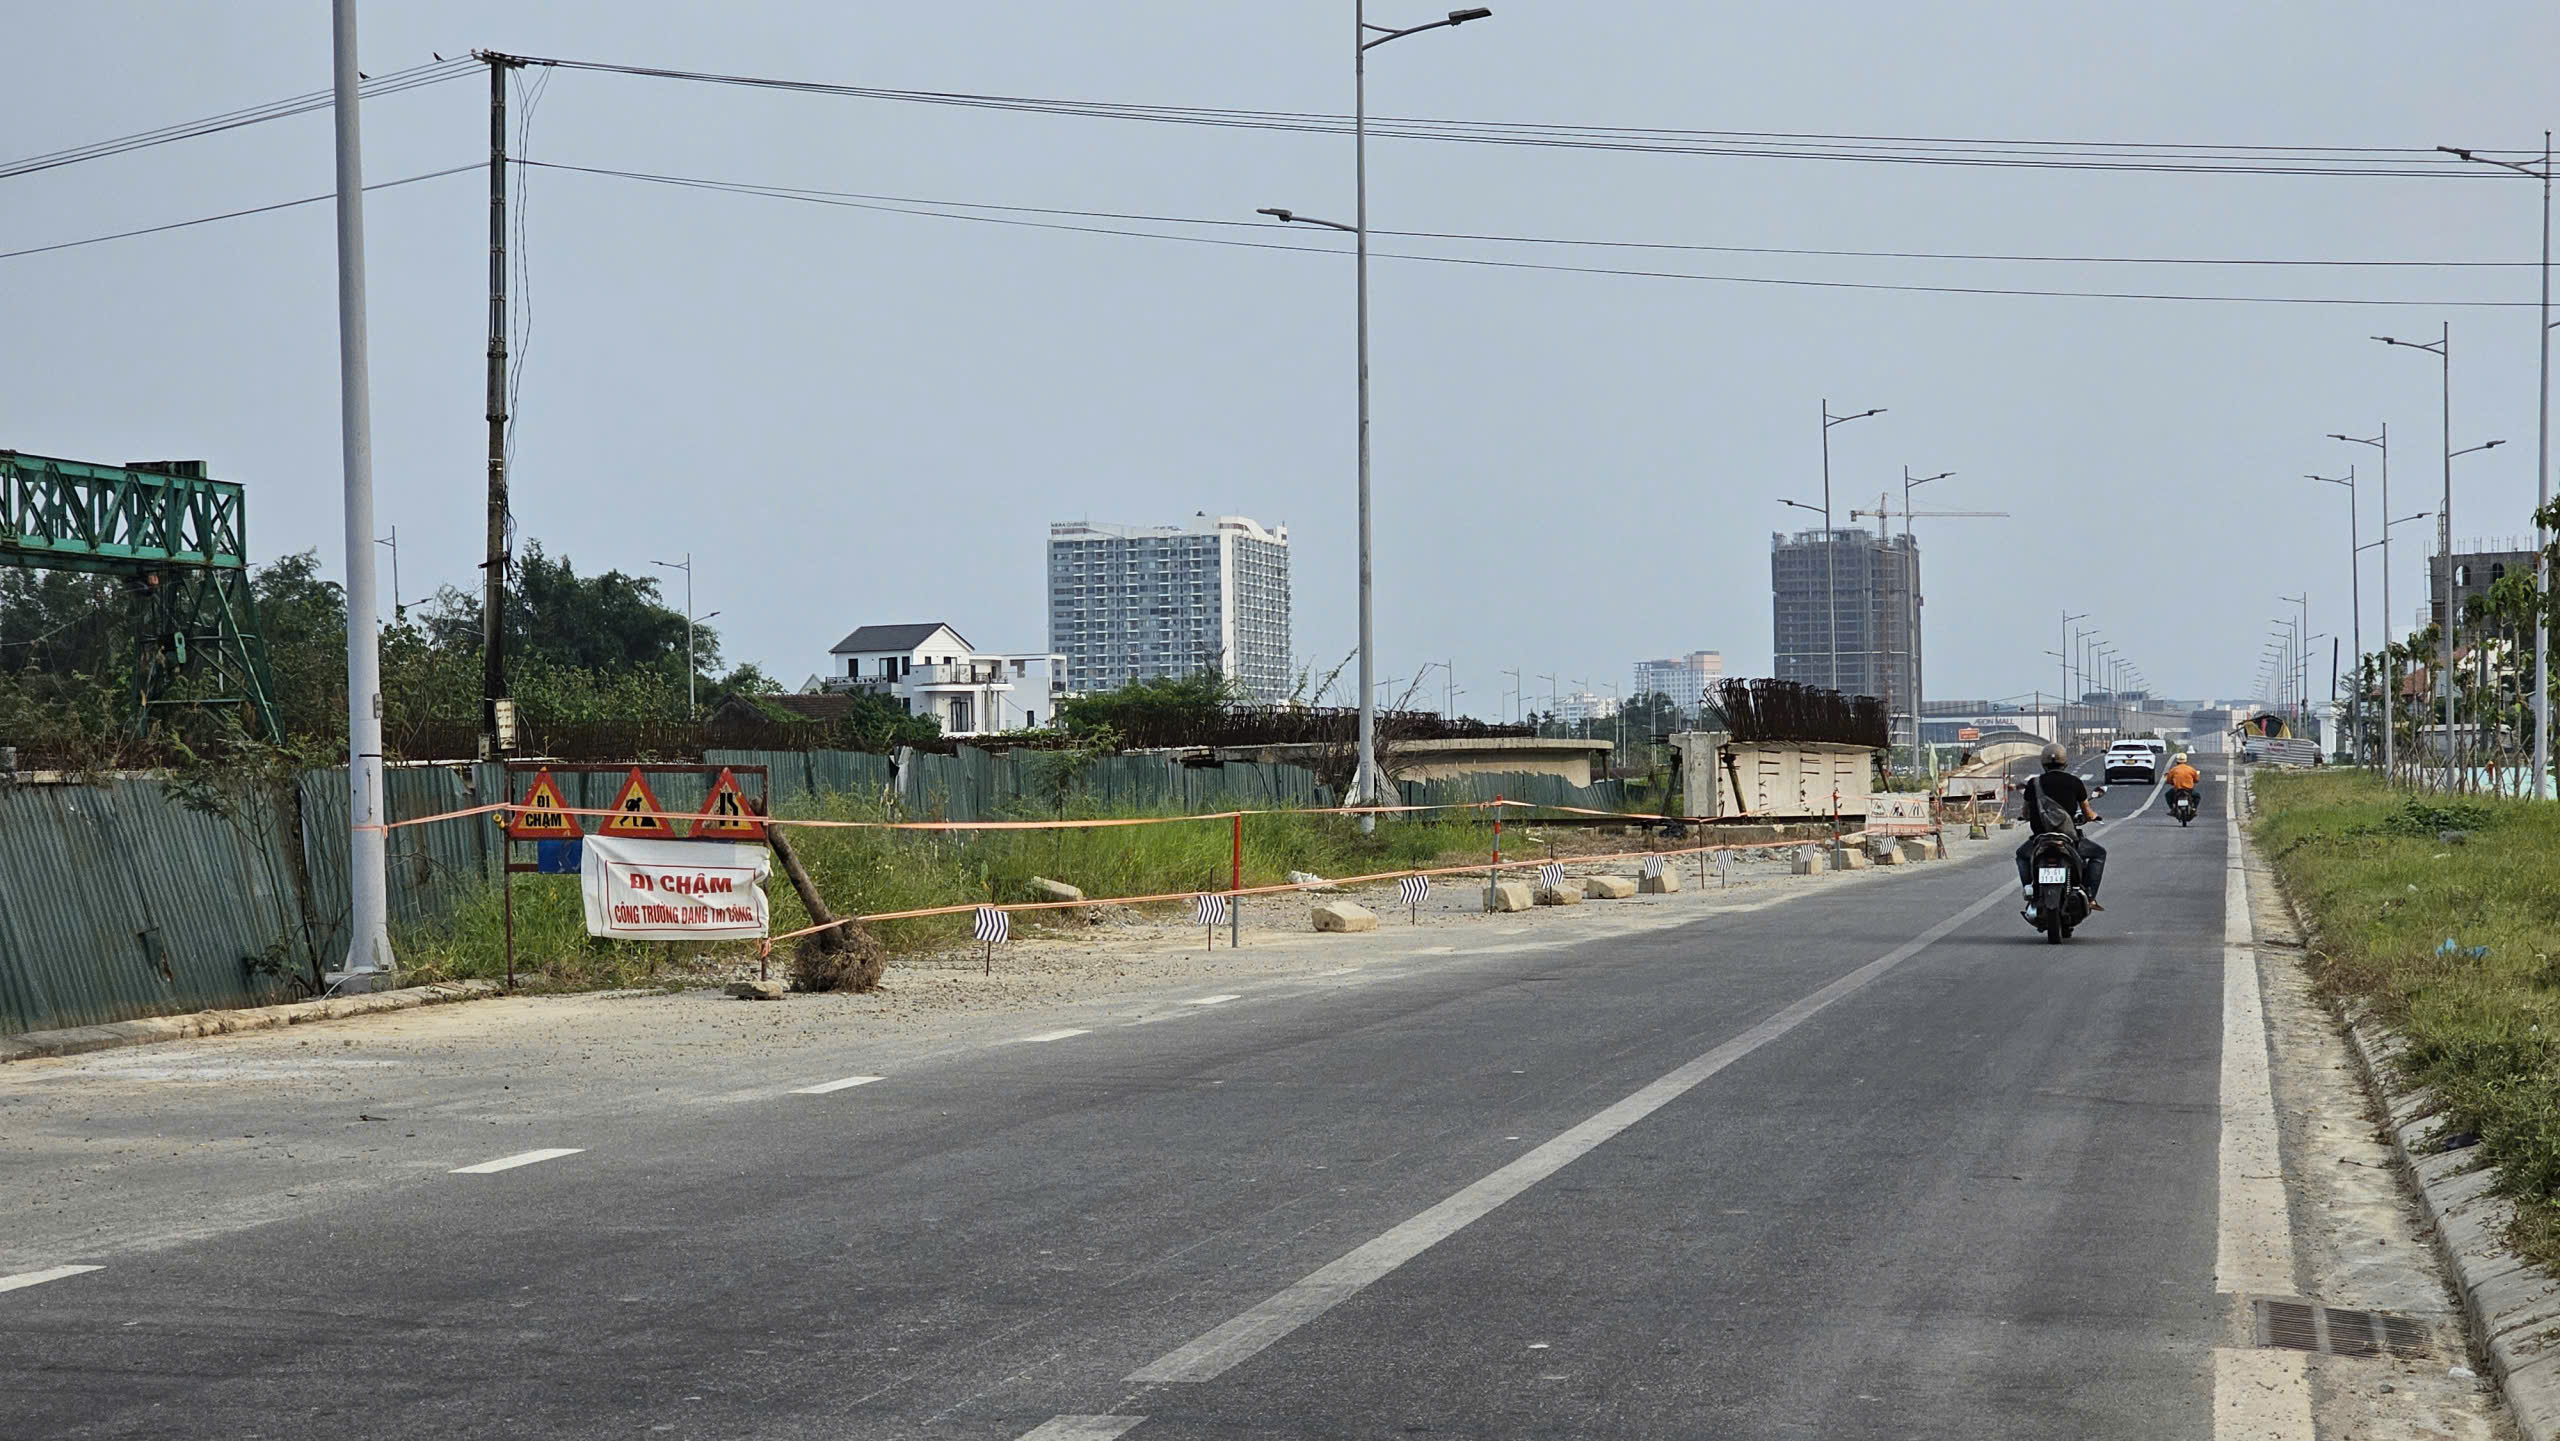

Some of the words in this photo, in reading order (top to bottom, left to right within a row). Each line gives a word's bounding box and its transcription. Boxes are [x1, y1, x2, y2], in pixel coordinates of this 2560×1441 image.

[630, 873, 654, 891] ĐI
[660, 872, 732, 898] CHẬM
[614, 901, 640, 924] CÔNG
